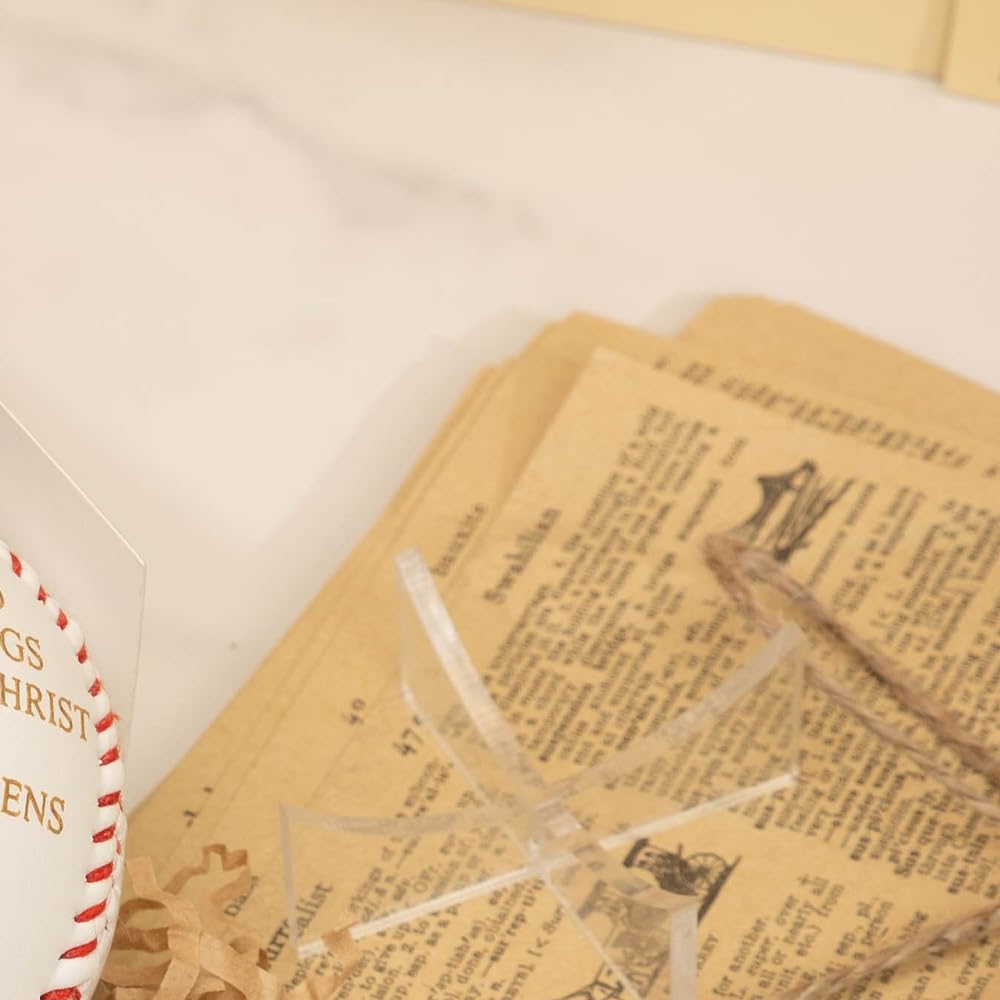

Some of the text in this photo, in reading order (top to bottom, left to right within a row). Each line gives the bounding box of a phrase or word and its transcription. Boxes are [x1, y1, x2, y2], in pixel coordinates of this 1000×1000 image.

[815, 884, 844, 918] from
[413, 919, 430, 936] to
[860, 902, 890, 947] person
[758, 969, 775, 989] all
[770, 949, 786, 966] or
[782, 901, 815, 946] nearly
[359, 974, 376, 992] to
[373, 944, 396, 974] give
[958, 953, 981, 986] over
